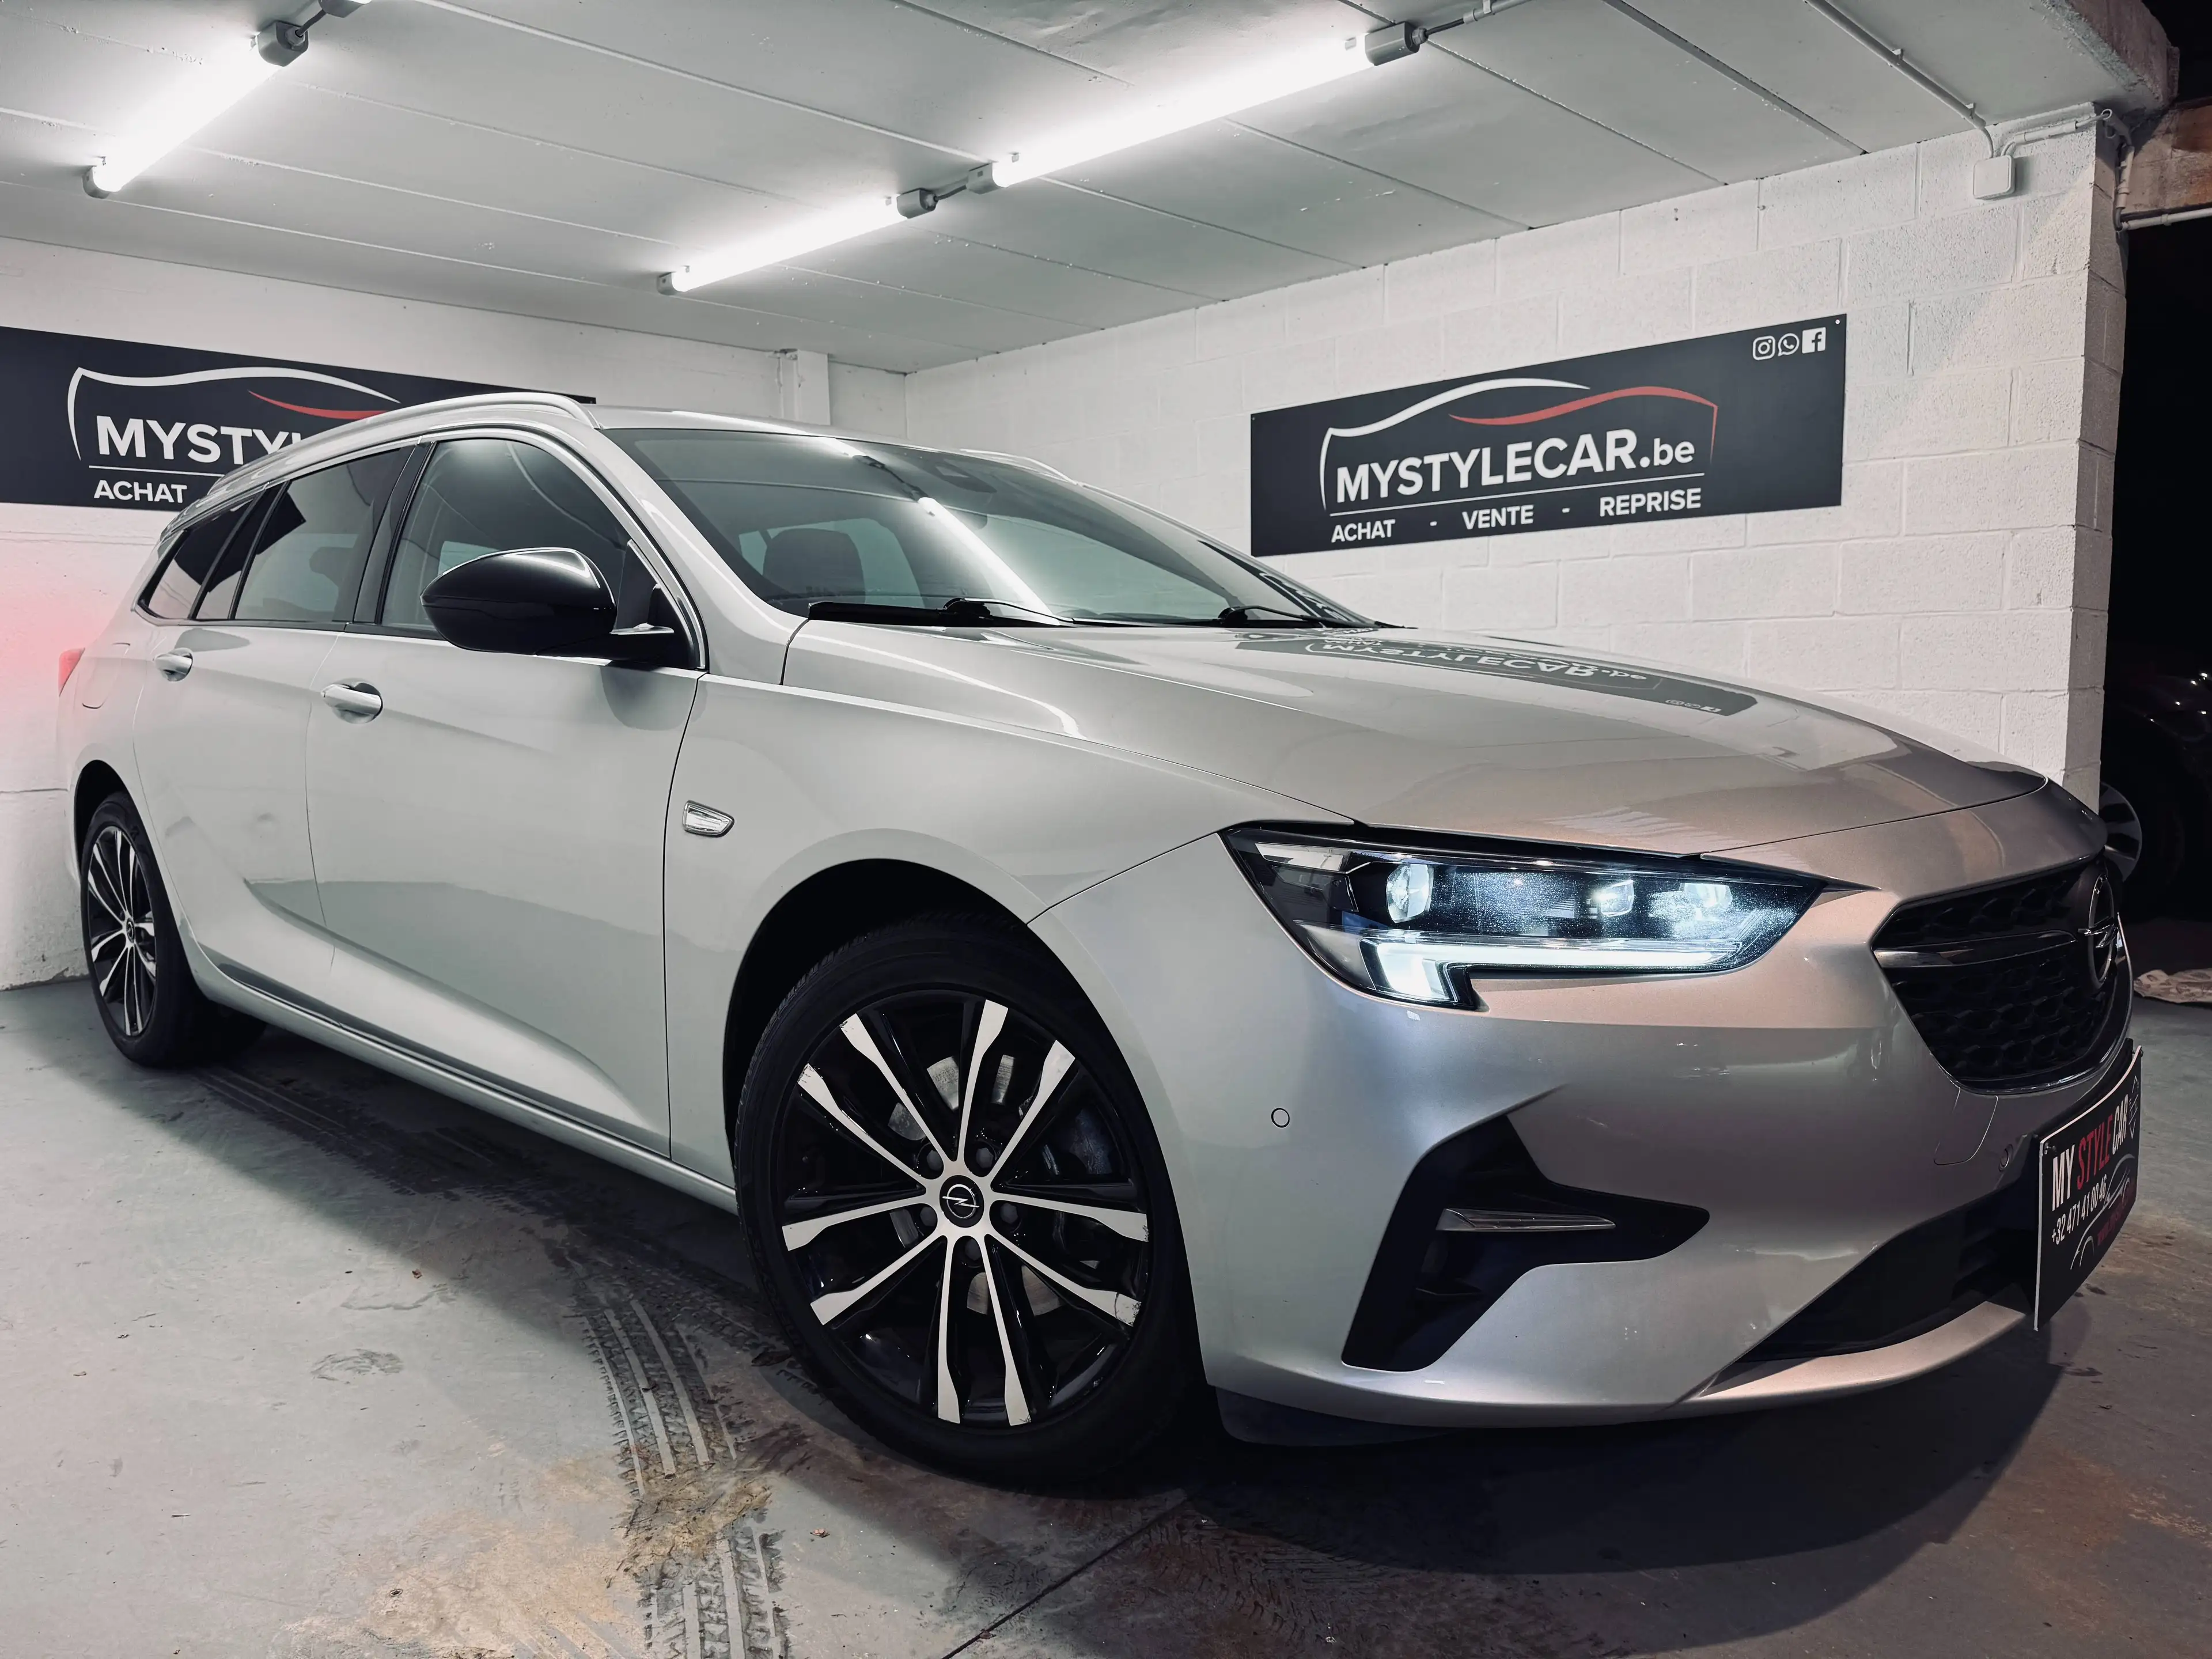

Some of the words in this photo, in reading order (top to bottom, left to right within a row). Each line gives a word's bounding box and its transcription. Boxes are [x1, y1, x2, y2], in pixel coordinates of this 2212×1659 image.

[96, 415, 301, 465] MYSTY
[1337, 429, 1695, 503] MYSTYLECAR.be
[93, 479, 187, 503] ACHAT
[1331, 518, 1396, 543] ACHAT
[1461, 504, 1534, 530] VENTE
[1600, 487, 1702, 517] REPRISE
[2052, 1144, 2075, 1211] MY
[2077, 1114, 2113, 1190] STYLE
[2112, 1094, 2128, 1155] CAR
[2052, 1213, 2066, 1245] +32
[2066, 1200, 2081, 1234] 471
[2081, 1191, 2090, 1220] 41
[2090, 1183, 2100, 1212] 00
[2099, 1174, 2107, 1202] 46
